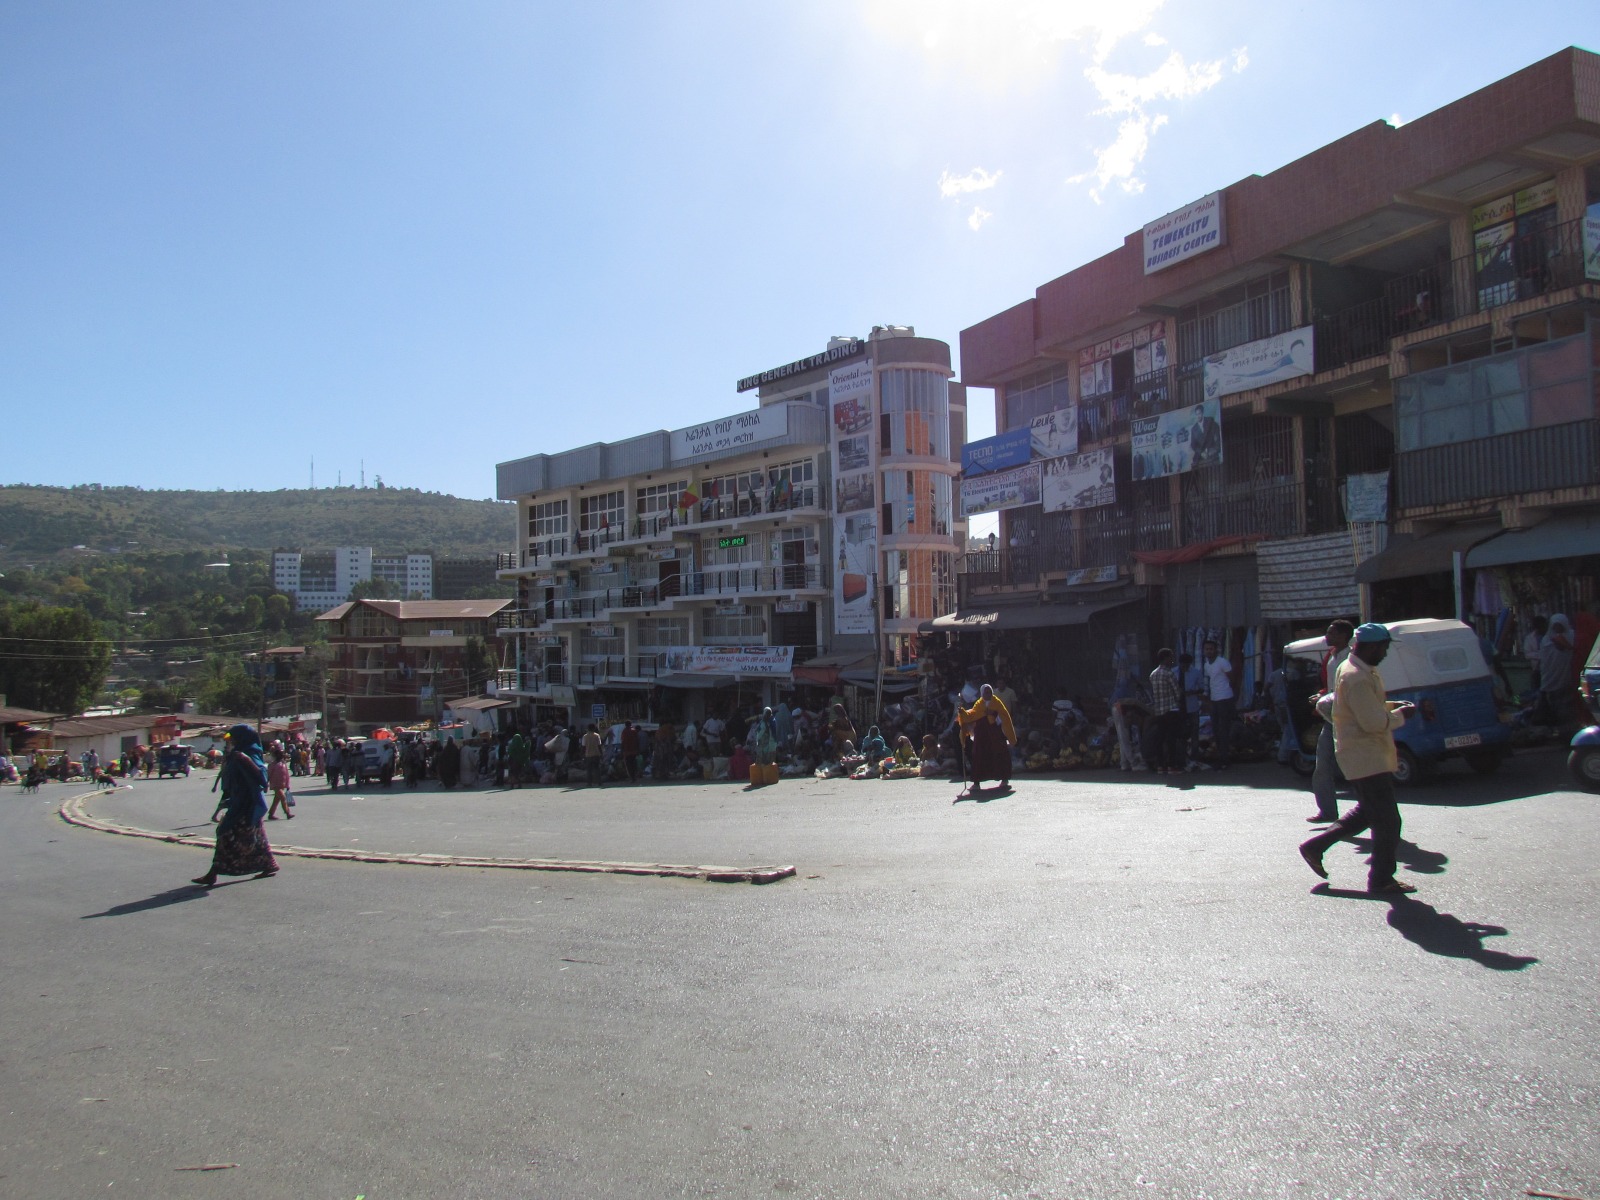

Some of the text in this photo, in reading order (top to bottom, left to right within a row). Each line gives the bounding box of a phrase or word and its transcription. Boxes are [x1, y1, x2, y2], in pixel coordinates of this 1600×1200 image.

[1152, 215, 1209, 251] TEWEKELTU
[1147, 229, 1217, 268] BUSINESS CENTER
[737, 342, 858, 390] KING GENERAL TRADING
[832, 369, 859, 385] Oriental
[715, 420, 733, 435] የገበያ
[736, 413, 761, 429] ማዕከል
[968, 446, 993, 460] TECNO
